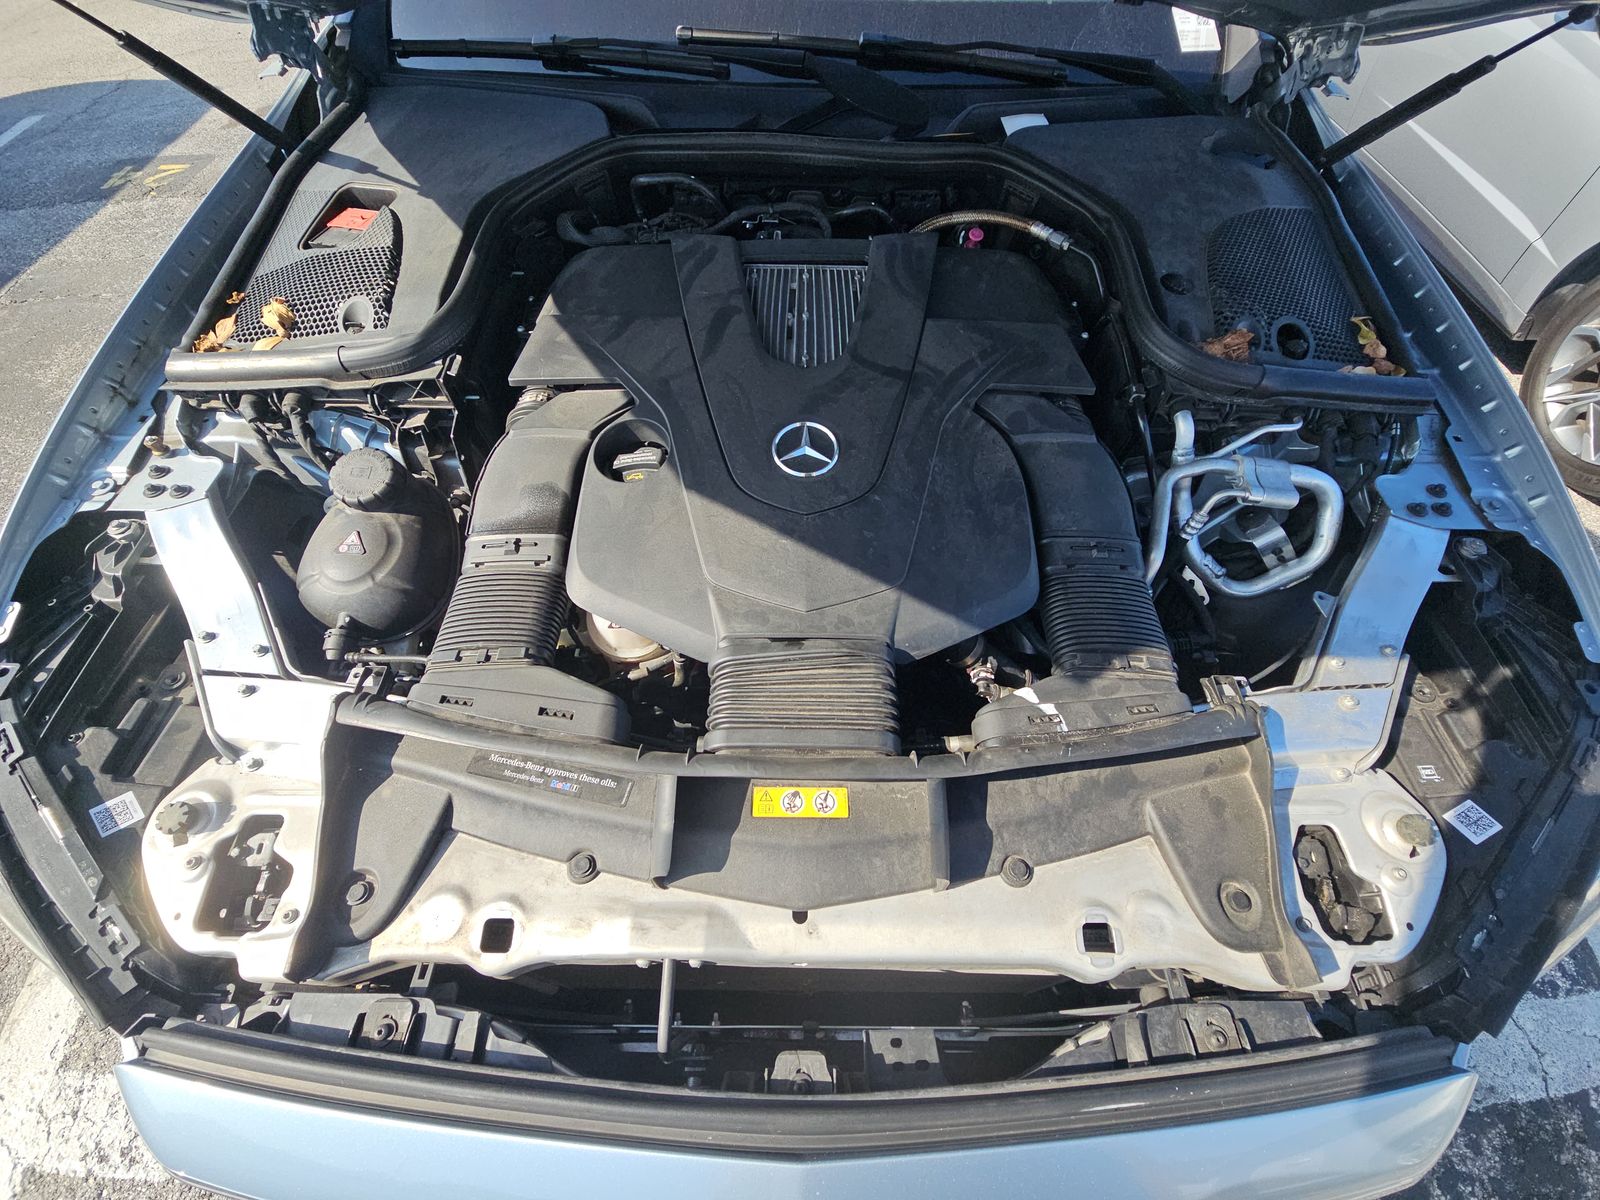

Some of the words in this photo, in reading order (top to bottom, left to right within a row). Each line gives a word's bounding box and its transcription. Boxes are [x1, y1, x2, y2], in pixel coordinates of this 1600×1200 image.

[489, 754, 545, 772] Mercedes-Benz
[545, 766, 578, 781] approves
[579, 773, 600, 785] these
[503, 769, 545, 784] Mercedes-Benz
